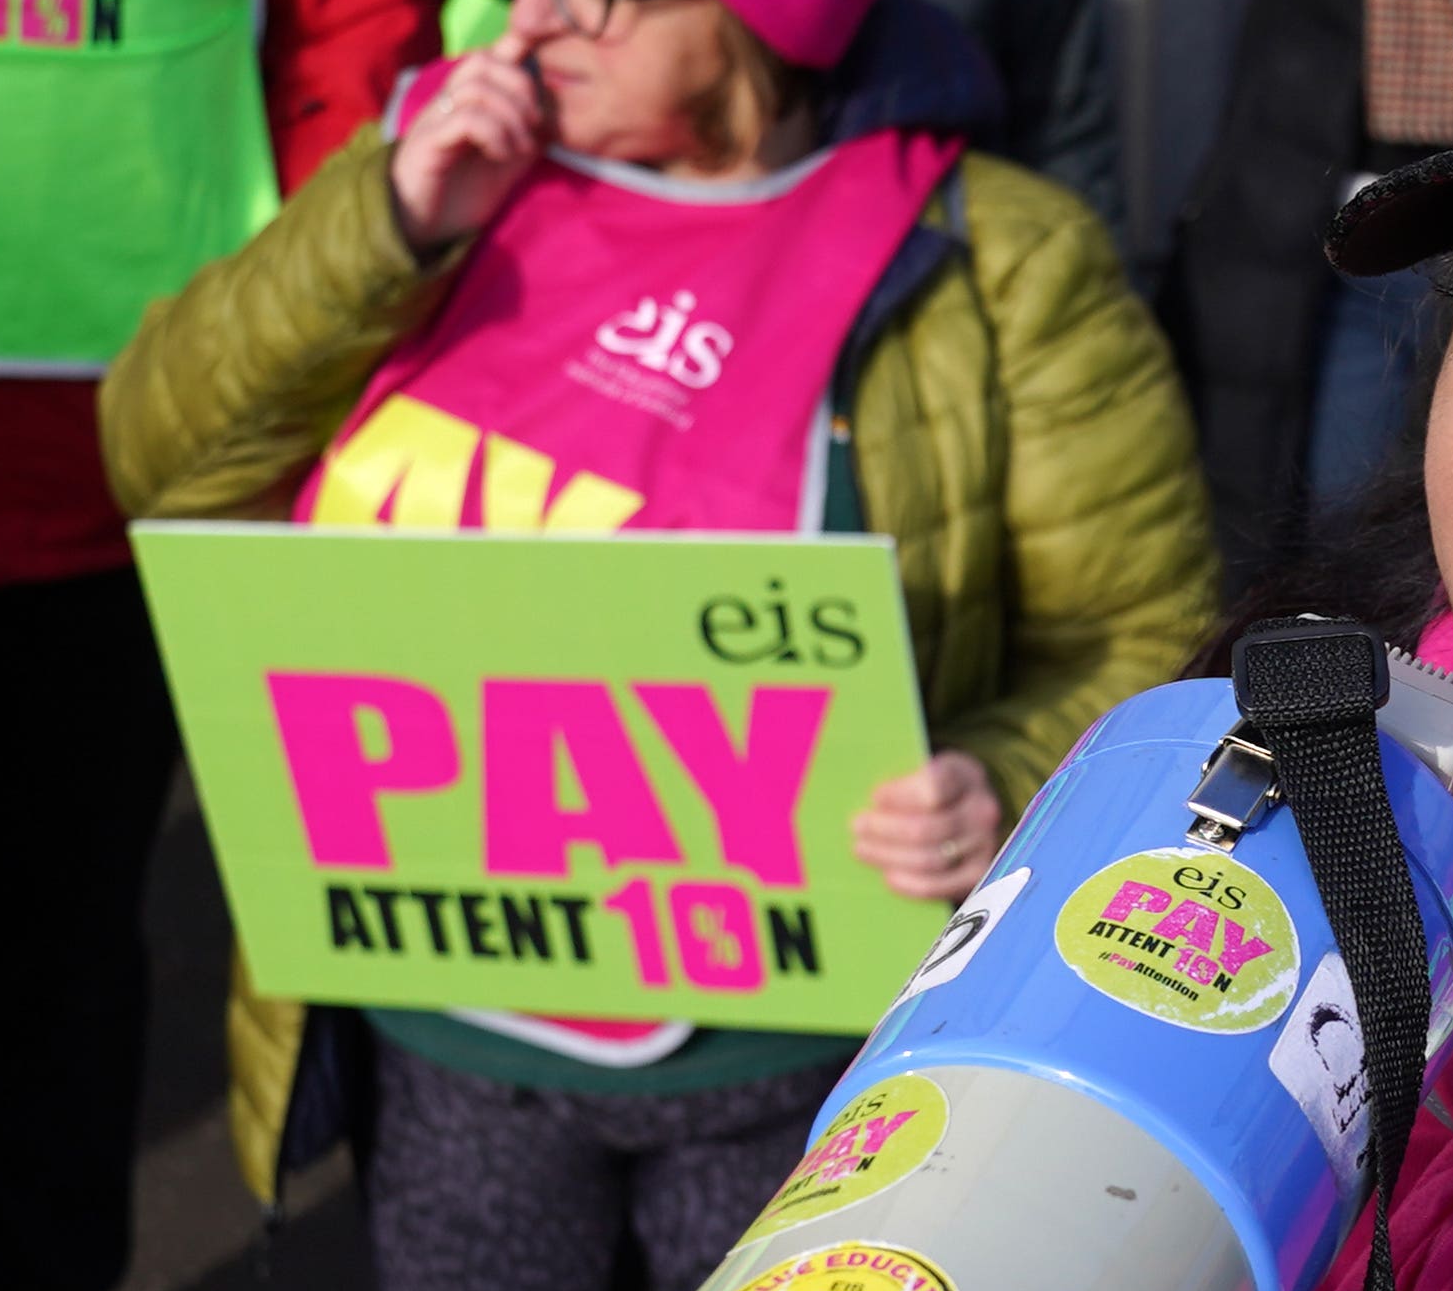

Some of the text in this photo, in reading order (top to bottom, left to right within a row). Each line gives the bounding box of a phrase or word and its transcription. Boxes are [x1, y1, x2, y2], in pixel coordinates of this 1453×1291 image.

[596, 289, 735, 389] eis
[311, 394, 645, 530] AY
[698, 580, 866, 668] eis
[264, 671, 833, 888] PAY
[1100, 879, 1275, 976] PAY
[1172, 866, 1247, 910] eis
[1097, 951, 1199, 1001] #PayAttention
